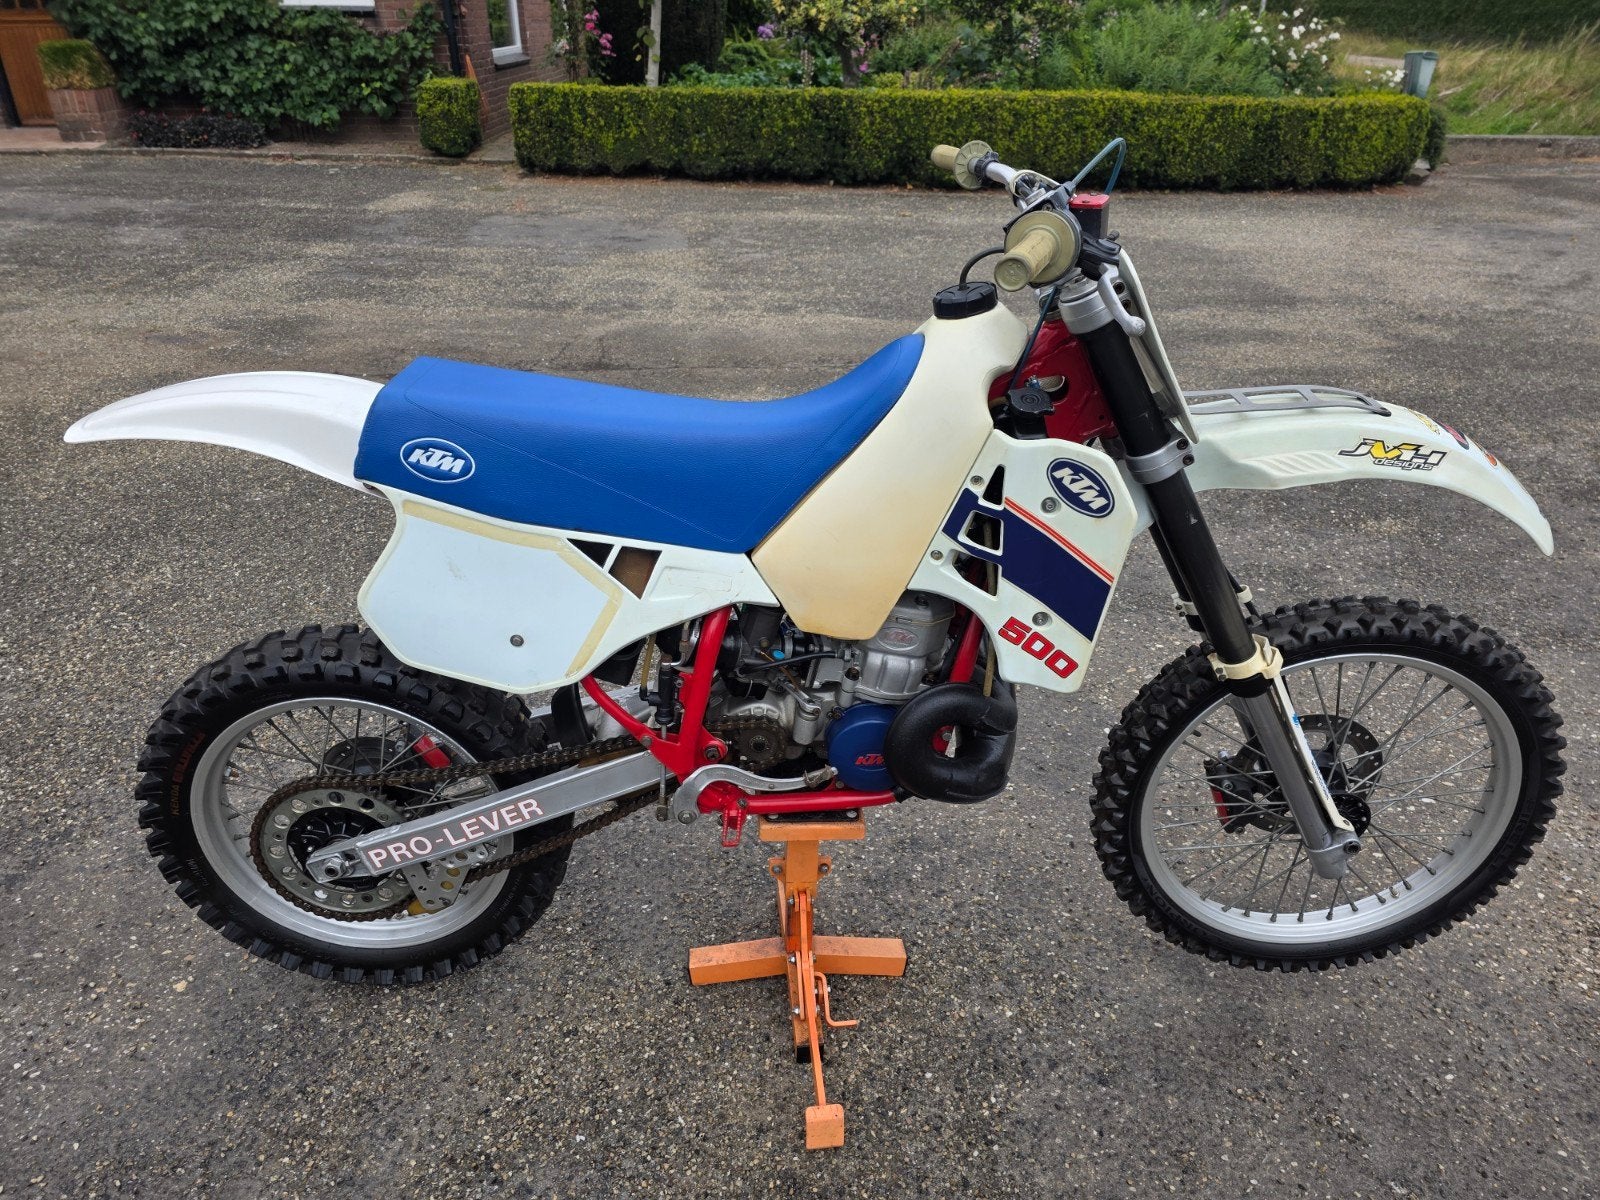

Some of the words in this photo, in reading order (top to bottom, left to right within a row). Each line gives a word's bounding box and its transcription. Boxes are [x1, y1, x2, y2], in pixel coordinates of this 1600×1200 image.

[407, 447, 466, 474] KTM
[1373, 458, 1435, 471] designs
[1051, 467, 1109, 511] KTM
[998, 616, 1079, 679] 500
[367, 798, 544, 868] PRO-LEVER
